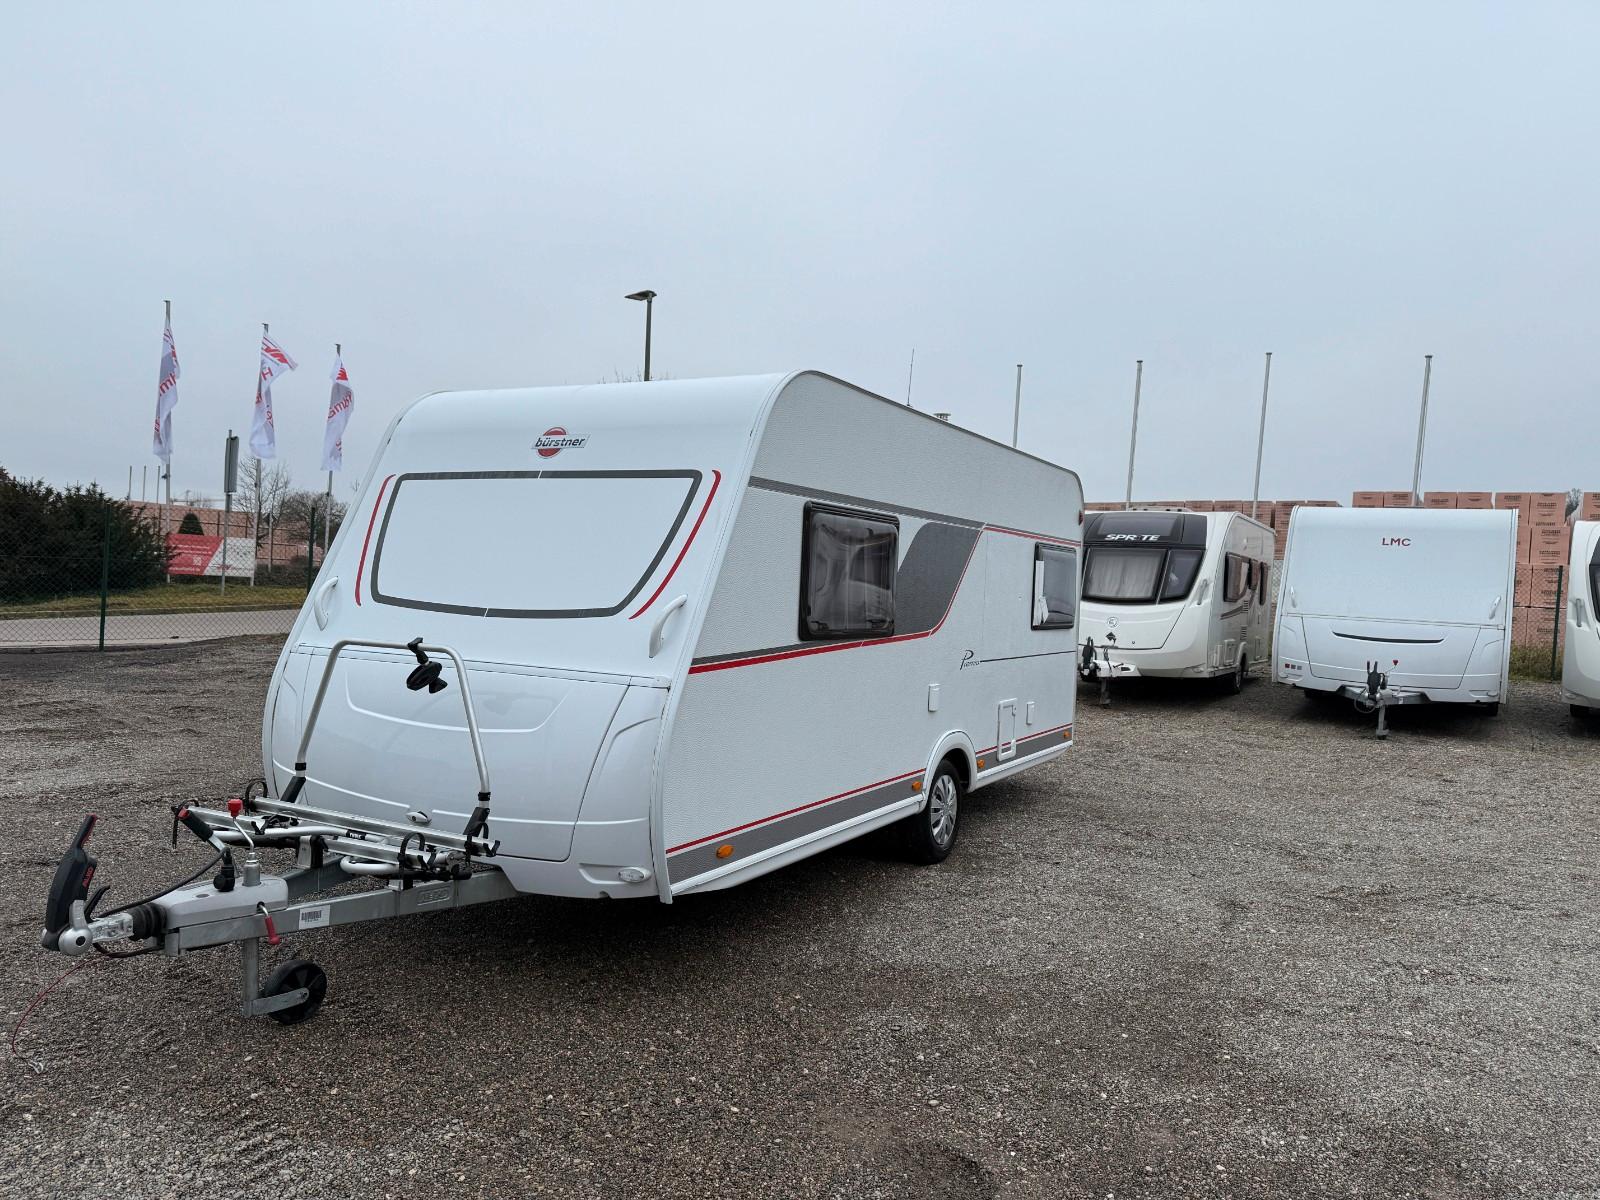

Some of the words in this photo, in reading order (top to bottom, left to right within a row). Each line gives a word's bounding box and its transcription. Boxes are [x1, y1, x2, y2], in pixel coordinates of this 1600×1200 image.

[535, 436, 586, 448] bürstner
[1104, 533, 1161, 541] SPRTE
[1381, 537, 1412, 547] LMC
